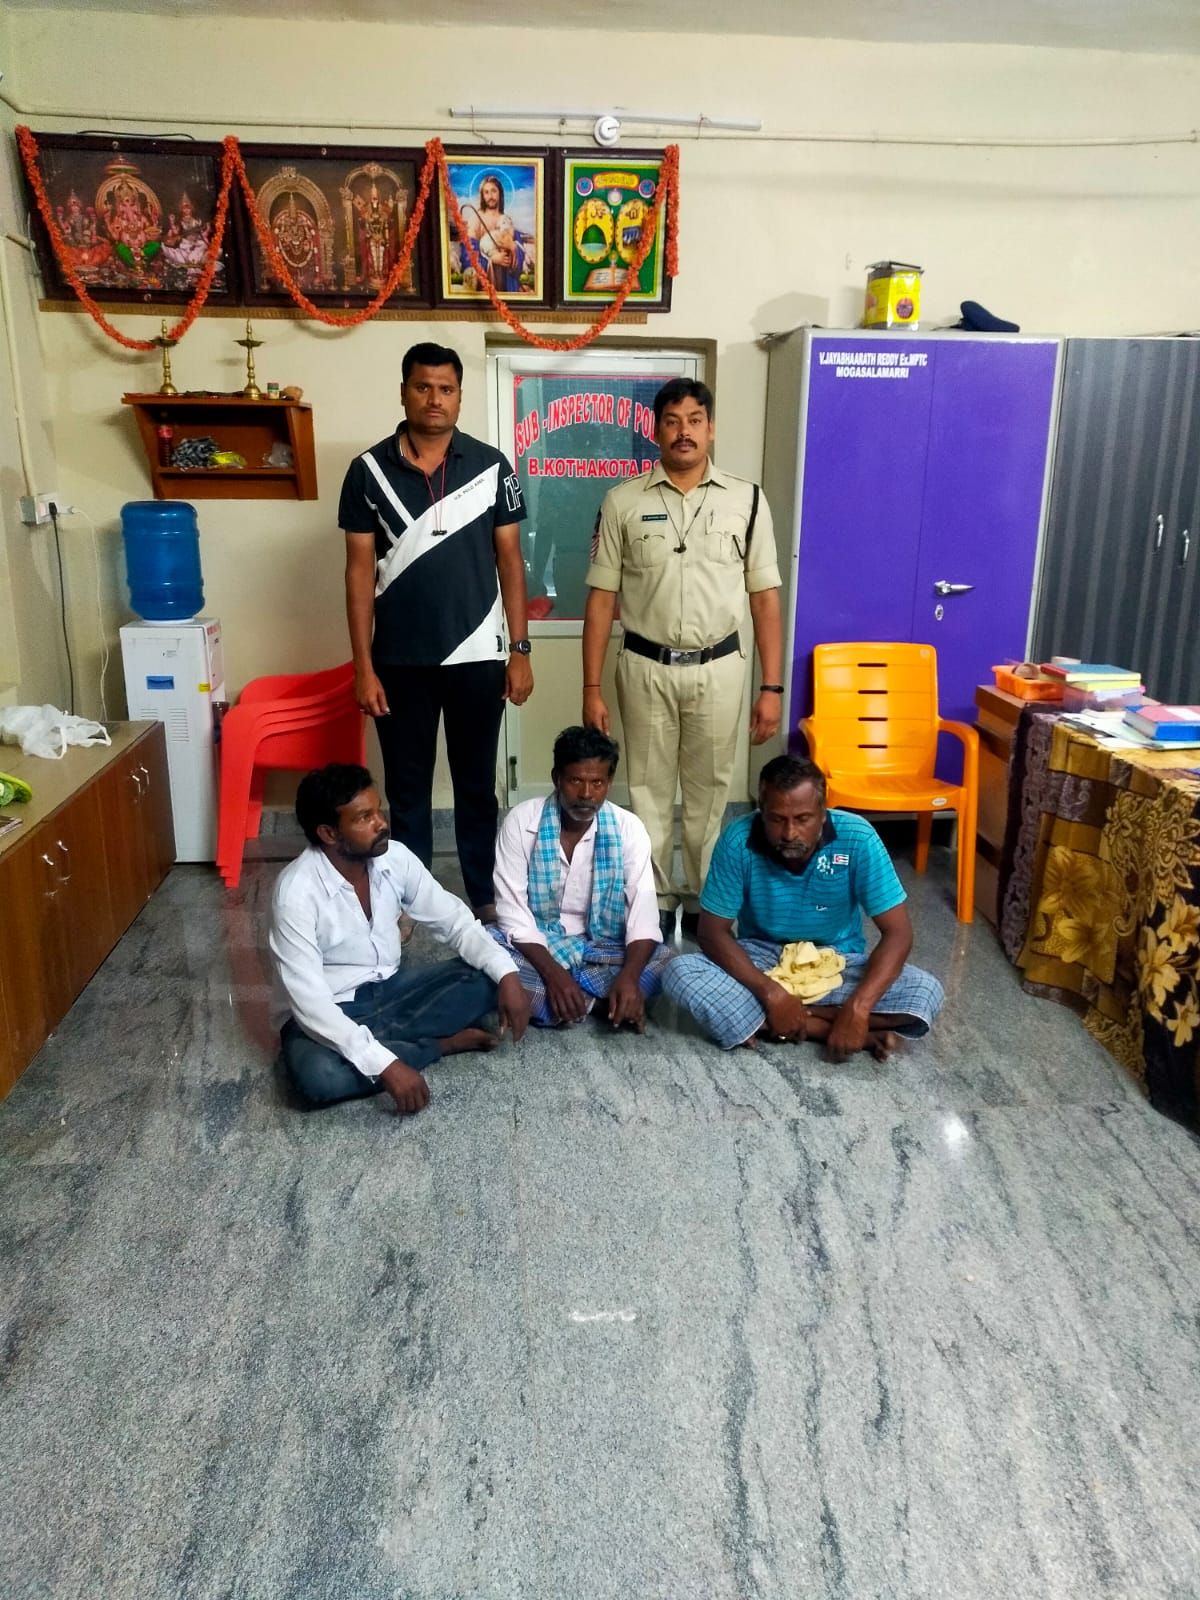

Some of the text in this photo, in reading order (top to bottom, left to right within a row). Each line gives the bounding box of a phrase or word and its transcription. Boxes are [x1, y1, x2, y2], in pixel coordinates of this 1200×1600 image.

[877, 353, 899, 366] REDDY
[835, 366, 909, 378] MOGASALAMARRI
[515, 410, 540, 456] SUB
[617, 397, 632, 427] OF
[528, 457, 639, 477] B.KOTHAKOTA
